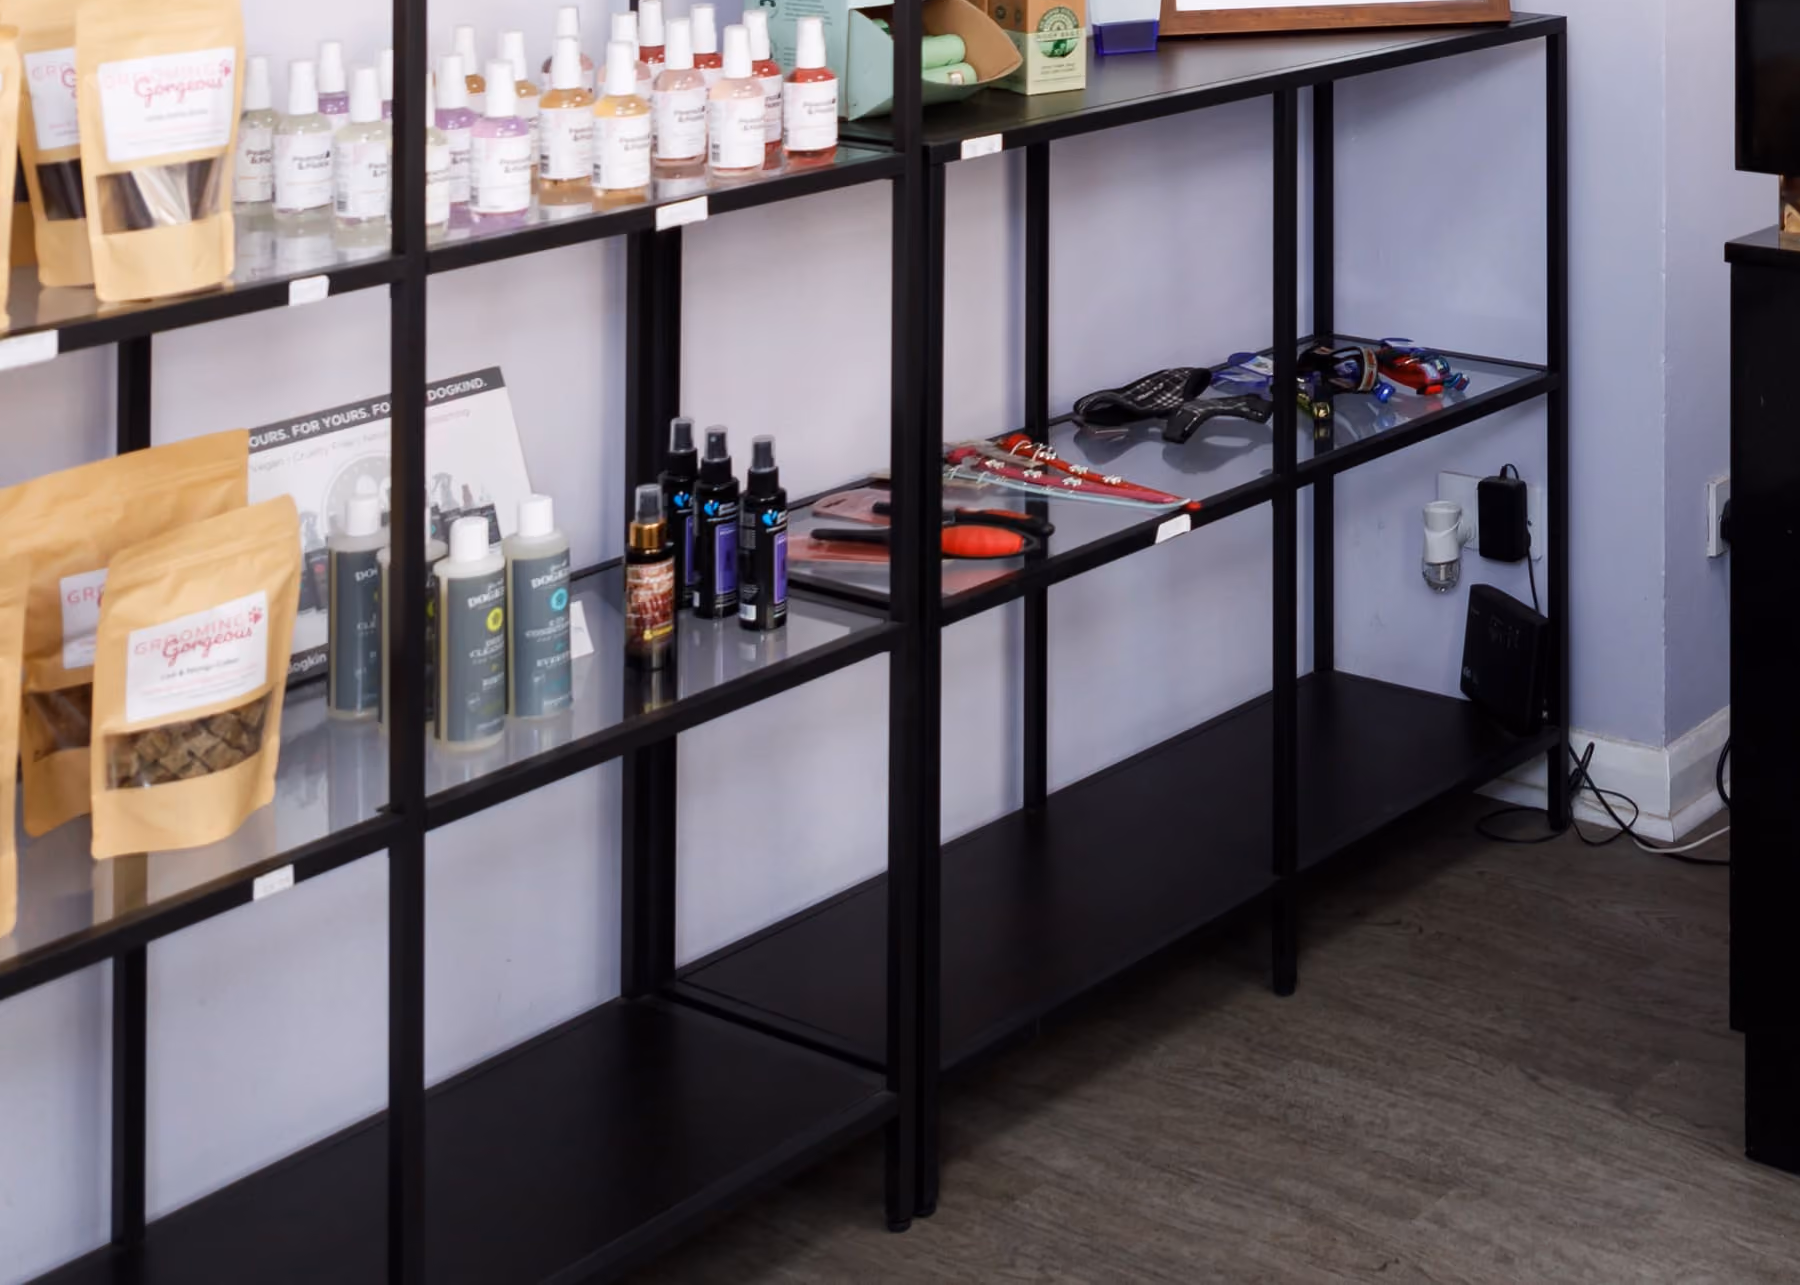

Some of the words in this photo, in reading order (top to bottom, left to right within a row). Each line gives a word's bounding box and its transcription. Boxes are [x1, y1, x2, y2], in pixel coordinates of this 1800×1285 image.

[291, 420, 321, 438] FOR
[322, 407, 371, 431] YOURS.
[427, 377, 488, 402] DOGKIND.
[162, 626, 253, 668] Gorgeous
